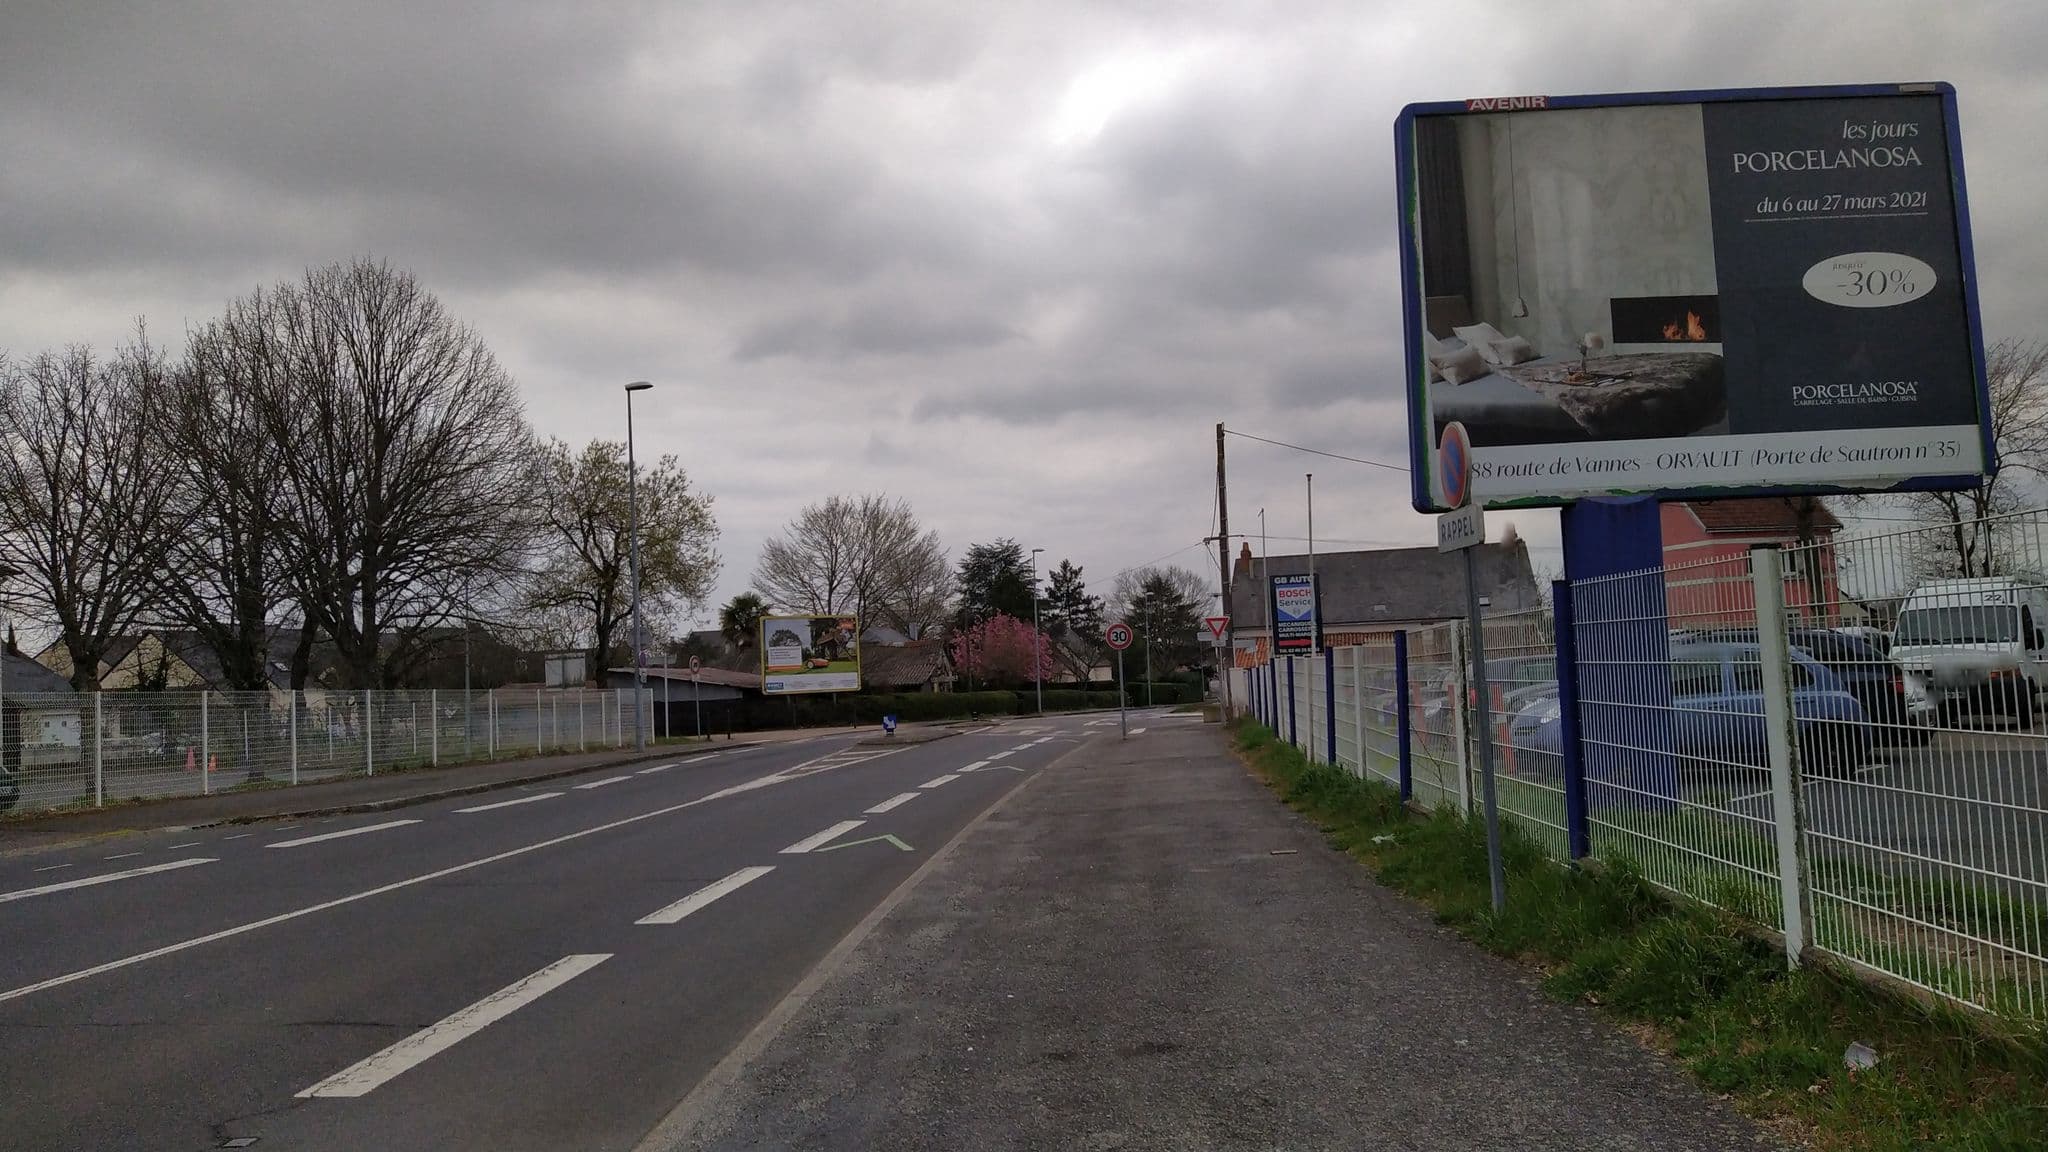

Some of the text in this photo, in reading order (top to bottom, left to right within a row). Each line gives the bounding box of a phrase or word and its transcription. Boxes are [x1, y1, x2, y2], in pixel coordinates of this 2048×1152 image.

[1469, 96, 1545, 111] AVENIR
[1842, 120, 1919, 143] les jours
[1733, 146, 1922, 173] PORCELANOSA
[1757, 191, 1927, 214] du 6 au 27 mars 2021
[1836, 268, 1916, 297] -30%
[1497, 461, 1545, 477] route
[1549, 457, 1571, 474] de
[1576, 457, 1640, 472] Vannes
[1656, 449, 1743, 471] ORVAULT
[1750, 447, 1806, 467] (Porte
[1810, 445, 1833, 464] de
[1837, 445, 1911, 463] Sautron
[1441, 515, 1475, 544] RAPPEL
[1279, 589, 1312, 598] BOSCH
[1111, 631, 1127, 642] 30
